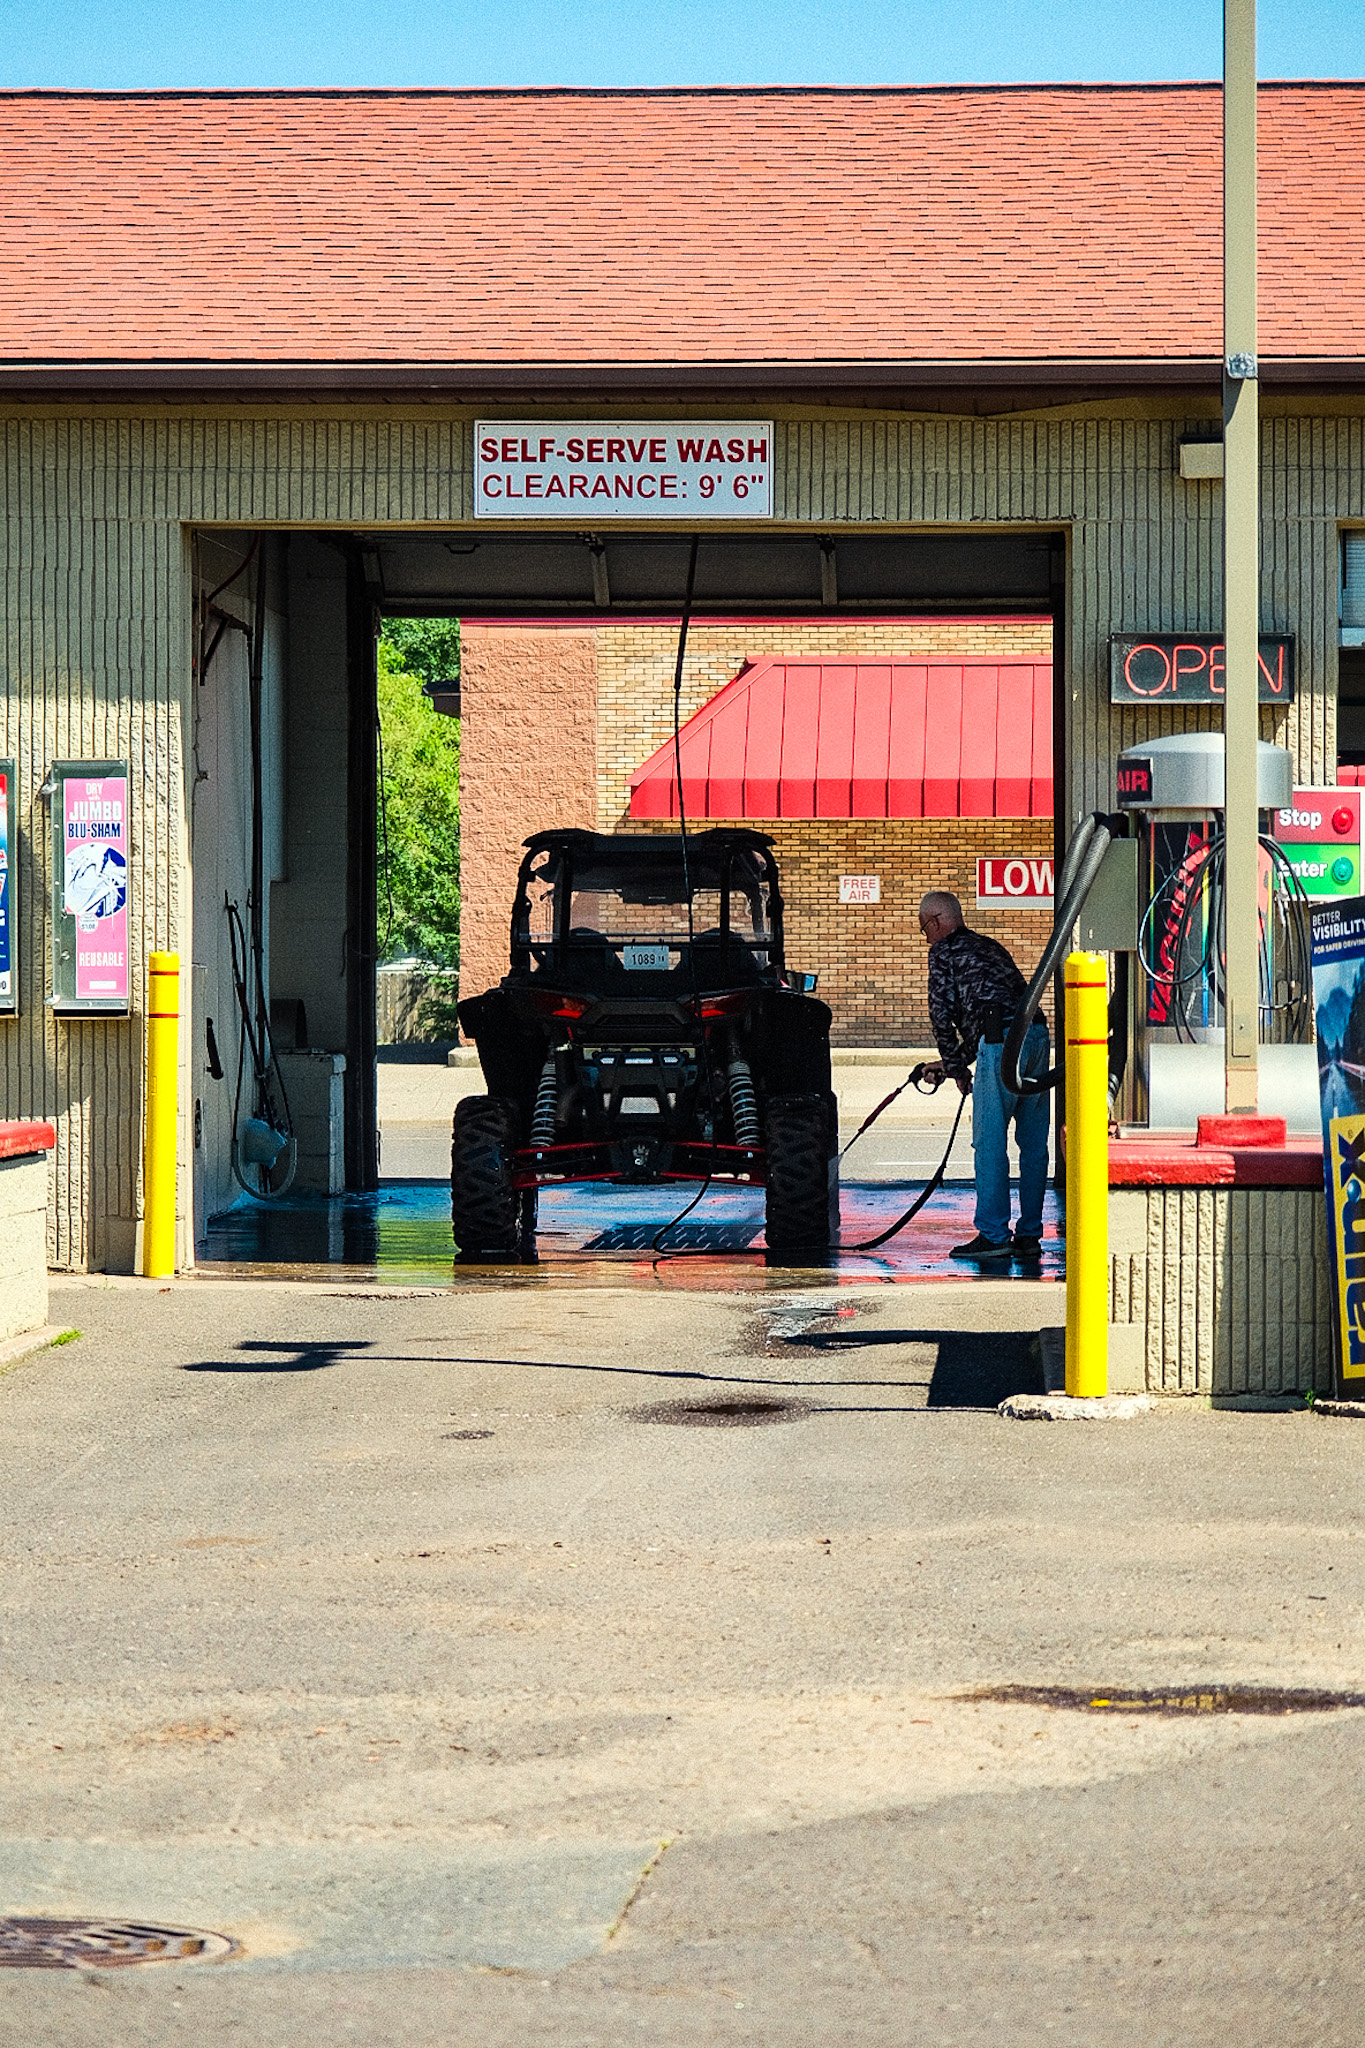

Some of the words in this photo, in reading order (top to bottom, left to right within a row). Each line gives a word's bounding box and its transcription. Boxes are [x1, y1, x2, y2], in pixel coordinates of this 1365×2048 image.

[480, 438, 667, 463] SELF-SERVE
[676, 438, 768, 463] WASH
[482, 474, 688, 499] CLEARANCE:
[699, 474, 723, 499] 9'
[732, 474, 764, 499] 6"
[85, 782, 104, 795] DRY
[1116, 770, 1149, 792] AIR
[69, 801, 122, 821] JUMBO
[1278, 808, 1323, 830] Stop
[68, 822, 121, 838] BLU-SHAM
[842, 878, 877, 890] FREE
[848, 889, 871, 901] AIR
[1313, 911, 1340, 926] BETTER
[79, 951, 124, 967] REUSABLE
[631, 953, 656, 966] 1089
